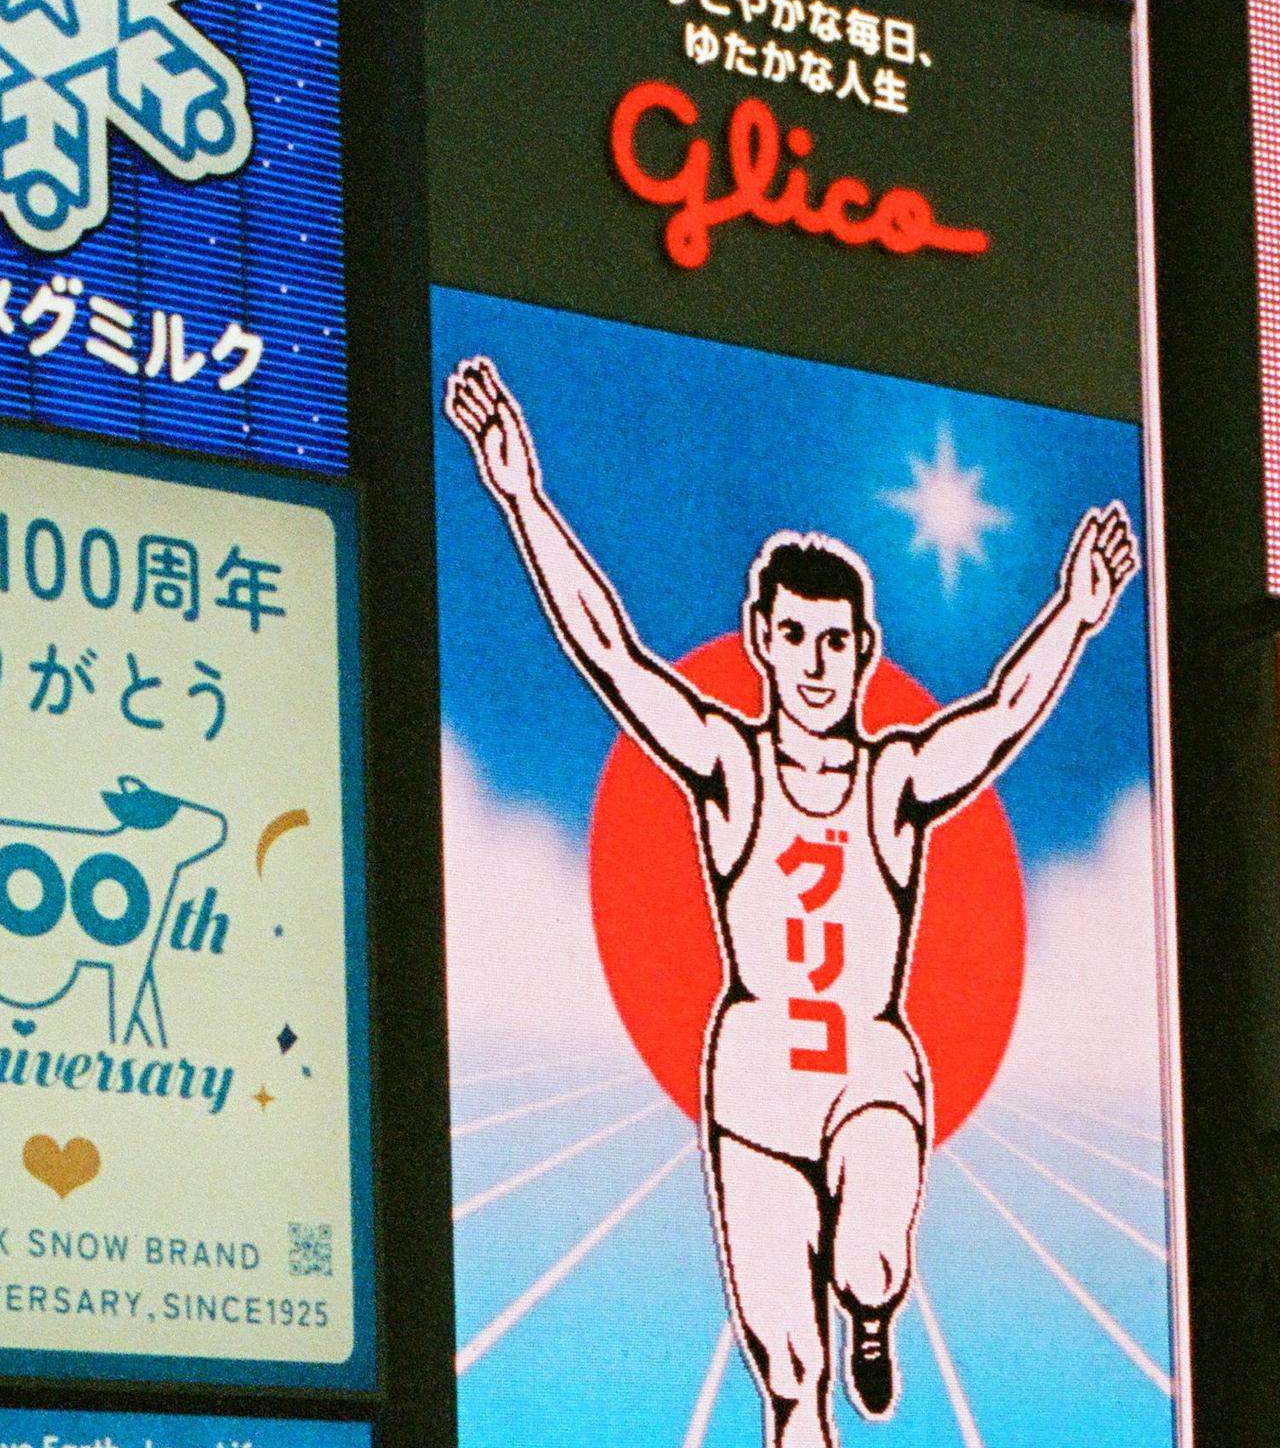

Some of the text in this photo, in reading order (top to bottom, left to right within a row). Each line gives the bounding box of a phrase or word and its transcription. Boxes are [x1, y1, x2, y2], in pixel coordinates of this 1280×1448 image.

[684, 20, 910, 115] ゆたかな人生
[610, 78, 991, 270] Glico
[775, 828, 849, 1076] グリコ
[28, 1229, 130, 1263] SNOW
[145, 1236, 262, 1270] BRAND
